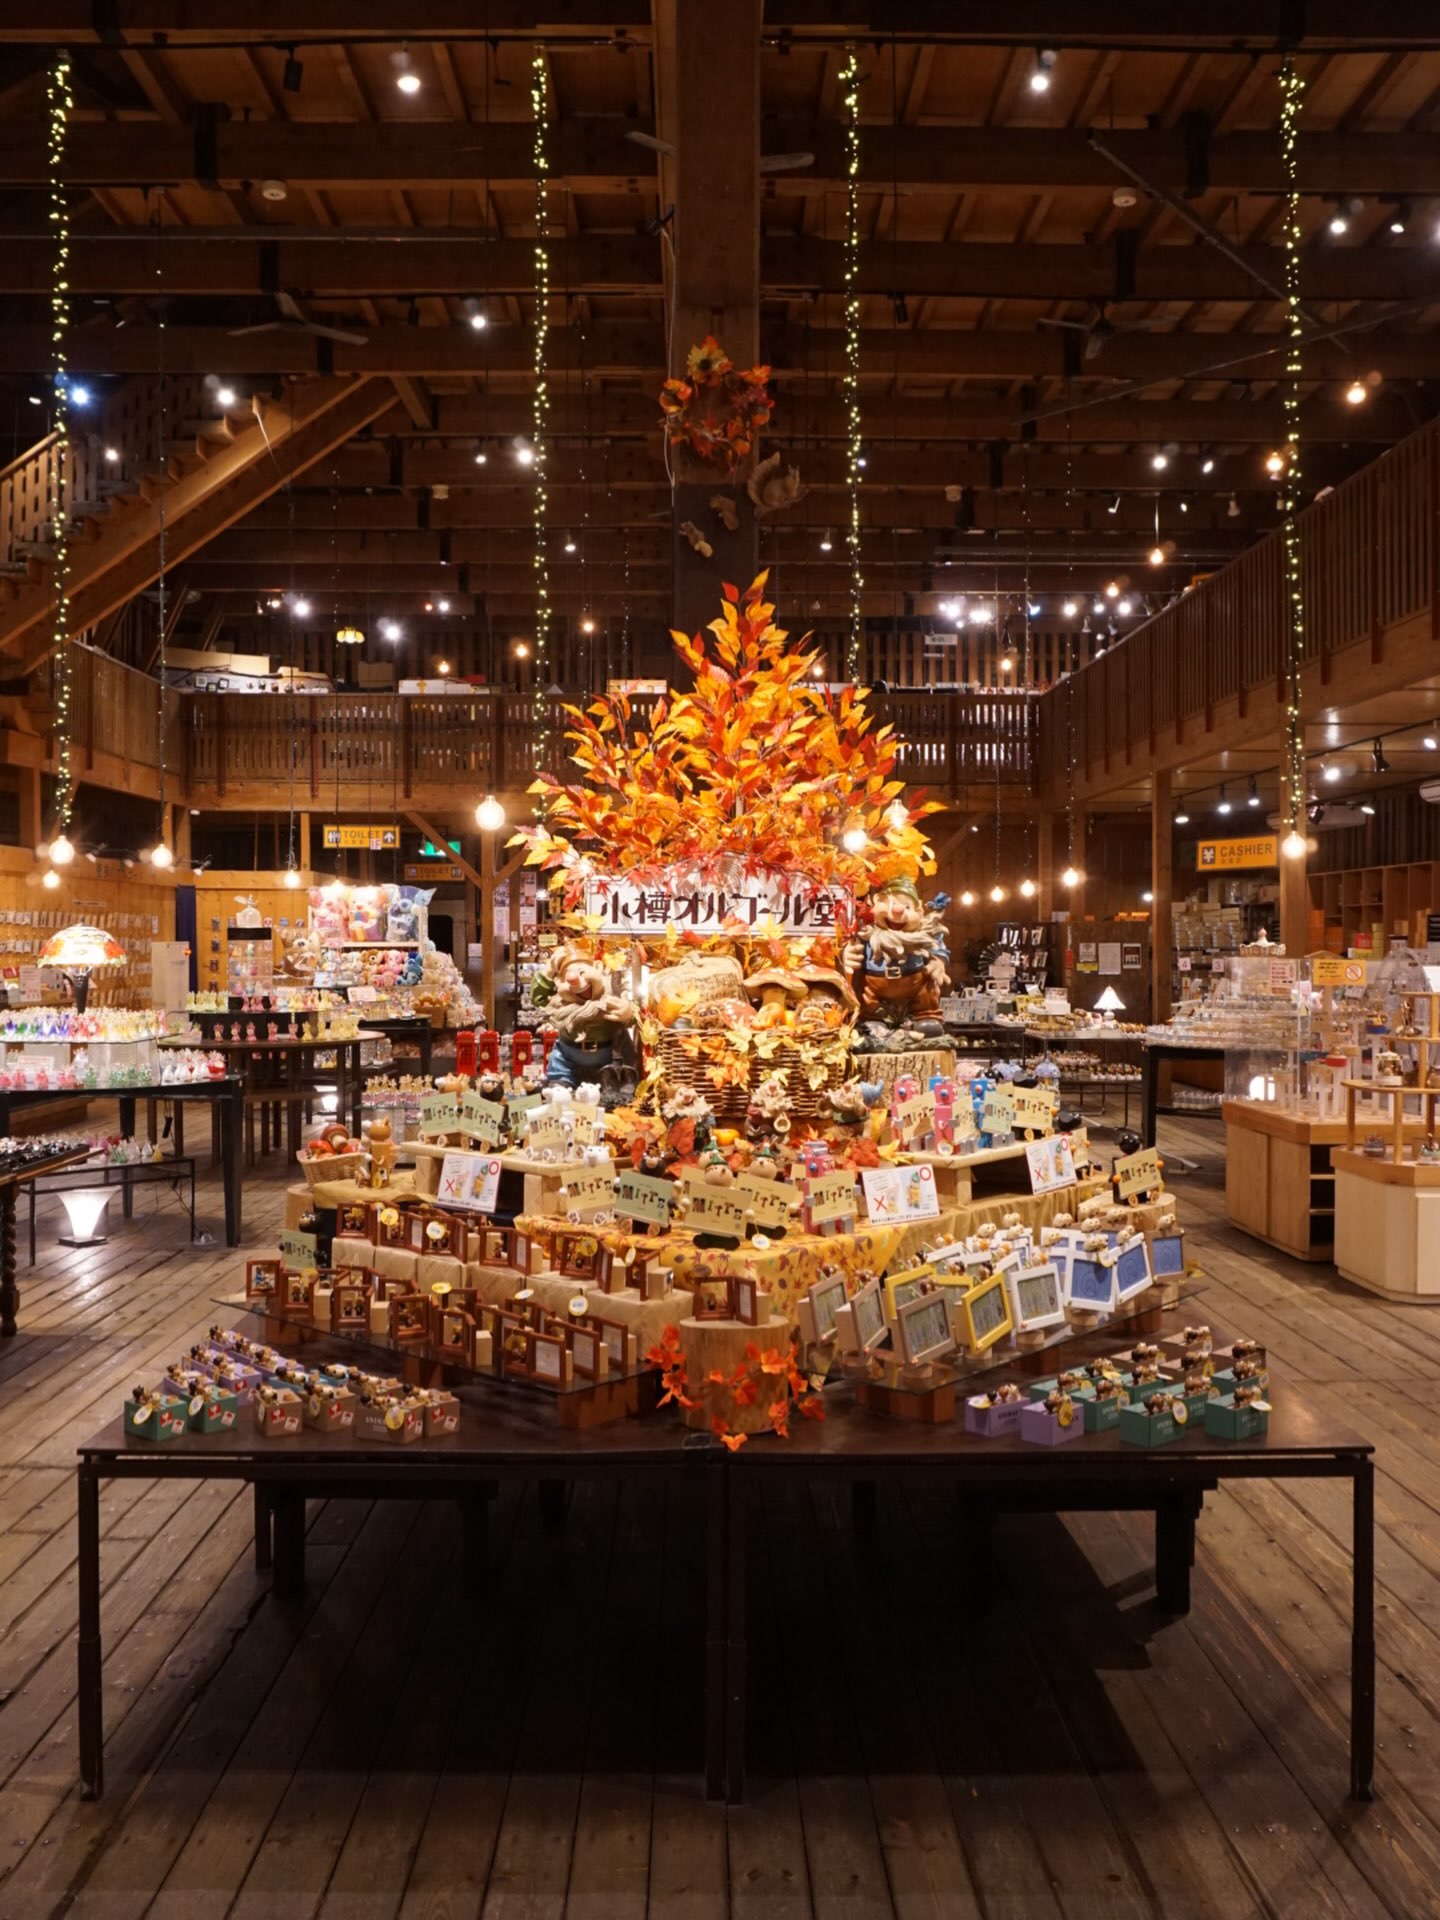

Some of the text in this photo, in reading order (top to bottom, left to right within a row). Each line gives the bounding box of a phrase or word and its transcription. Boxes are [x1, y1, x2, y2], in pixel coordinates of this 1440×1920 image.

[343, 830, 380, 839] TOILET
[1220, 843, 1273, 857] CASHIER
[600, 891, 838, 927] 小樽オルゴール堂
